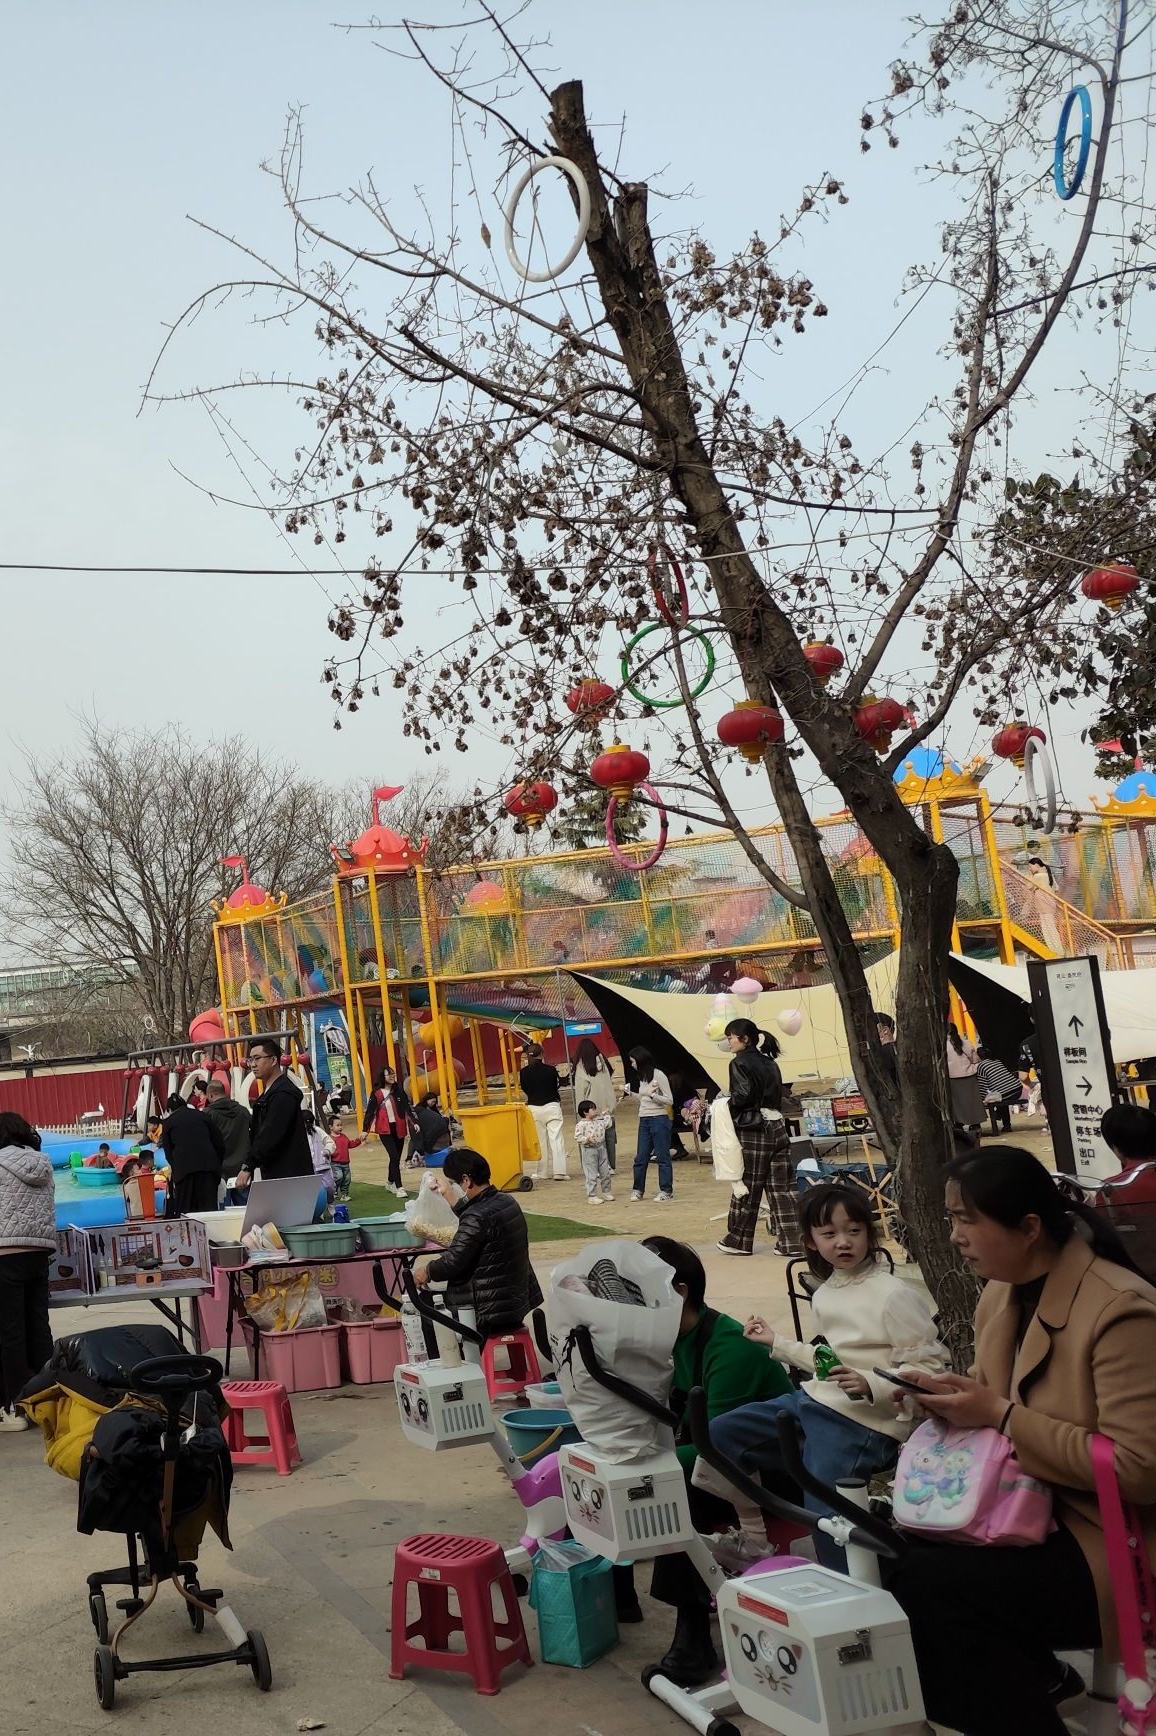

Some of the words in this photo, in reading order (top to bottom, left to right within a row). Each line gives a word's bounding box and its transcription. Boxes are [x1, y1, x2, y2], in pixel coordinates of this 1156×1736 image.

[1072, 1104, 1103, 1115] 营销中心
[1076, 1126, 1101, 1137] 停车场
[1079, 1148, 1095, 1158] 出口
